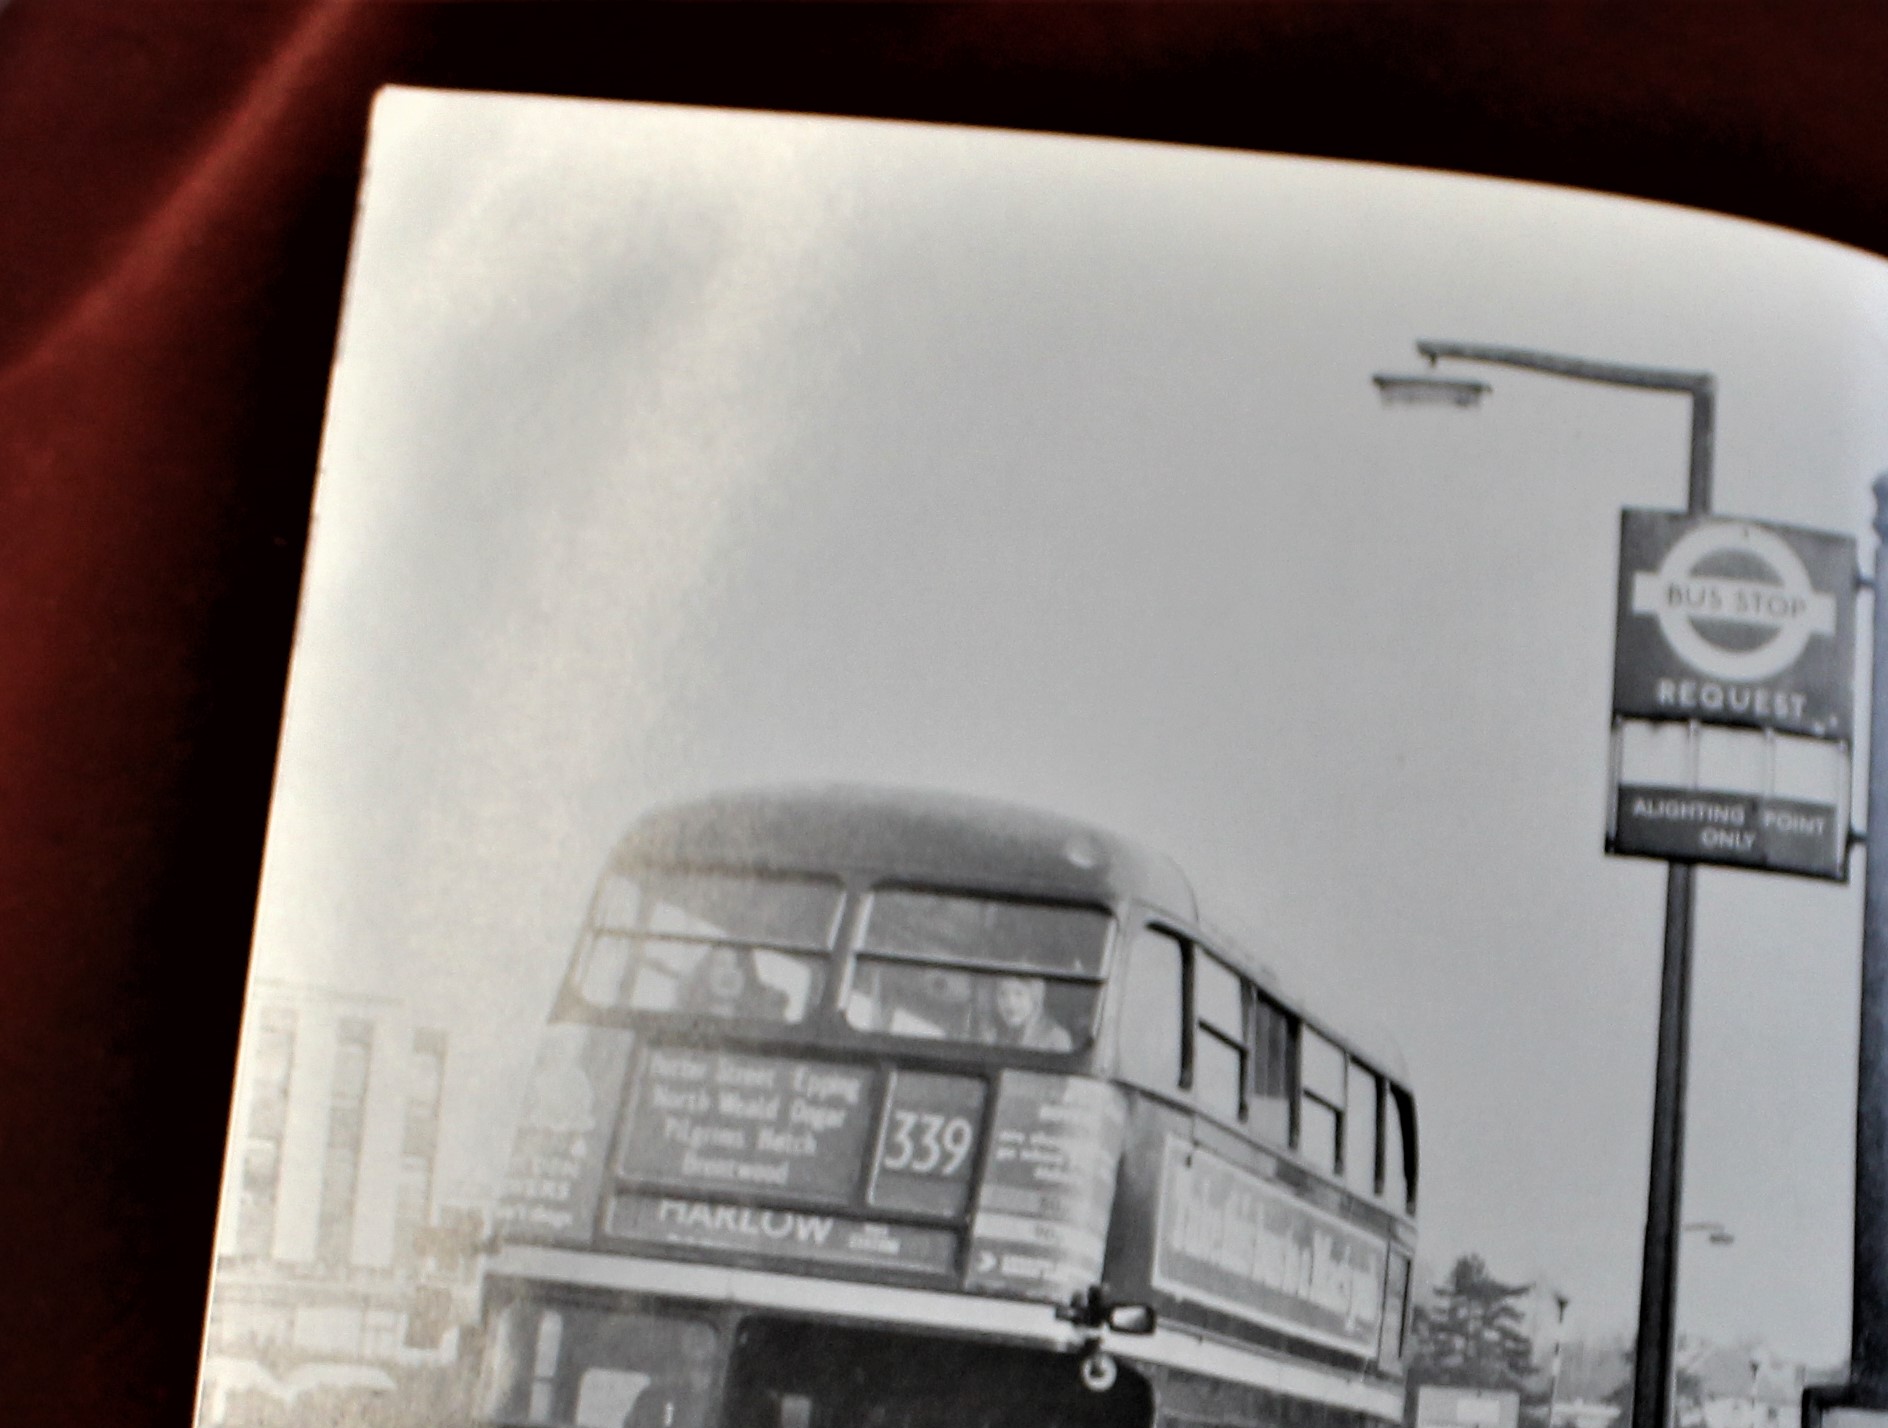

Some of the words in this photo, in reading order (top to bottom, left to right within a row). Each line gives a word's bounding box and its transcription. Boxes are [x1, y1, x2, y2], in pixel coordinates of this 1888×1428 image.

[1668, 582, 1722, 609] BUS
[1734, 590, 1808, 618] STOP
[1657, 678, 1806, 720] REQUEST
[1633, 797, 1744, 825] ALIGHTING
[1761, 810, 1825, 835] POINT
[1700, 827, 1757, 849] ONLY
[882, 1109, 972, 1176] 339
[658, 1200, 834, 1244] HARLOW
